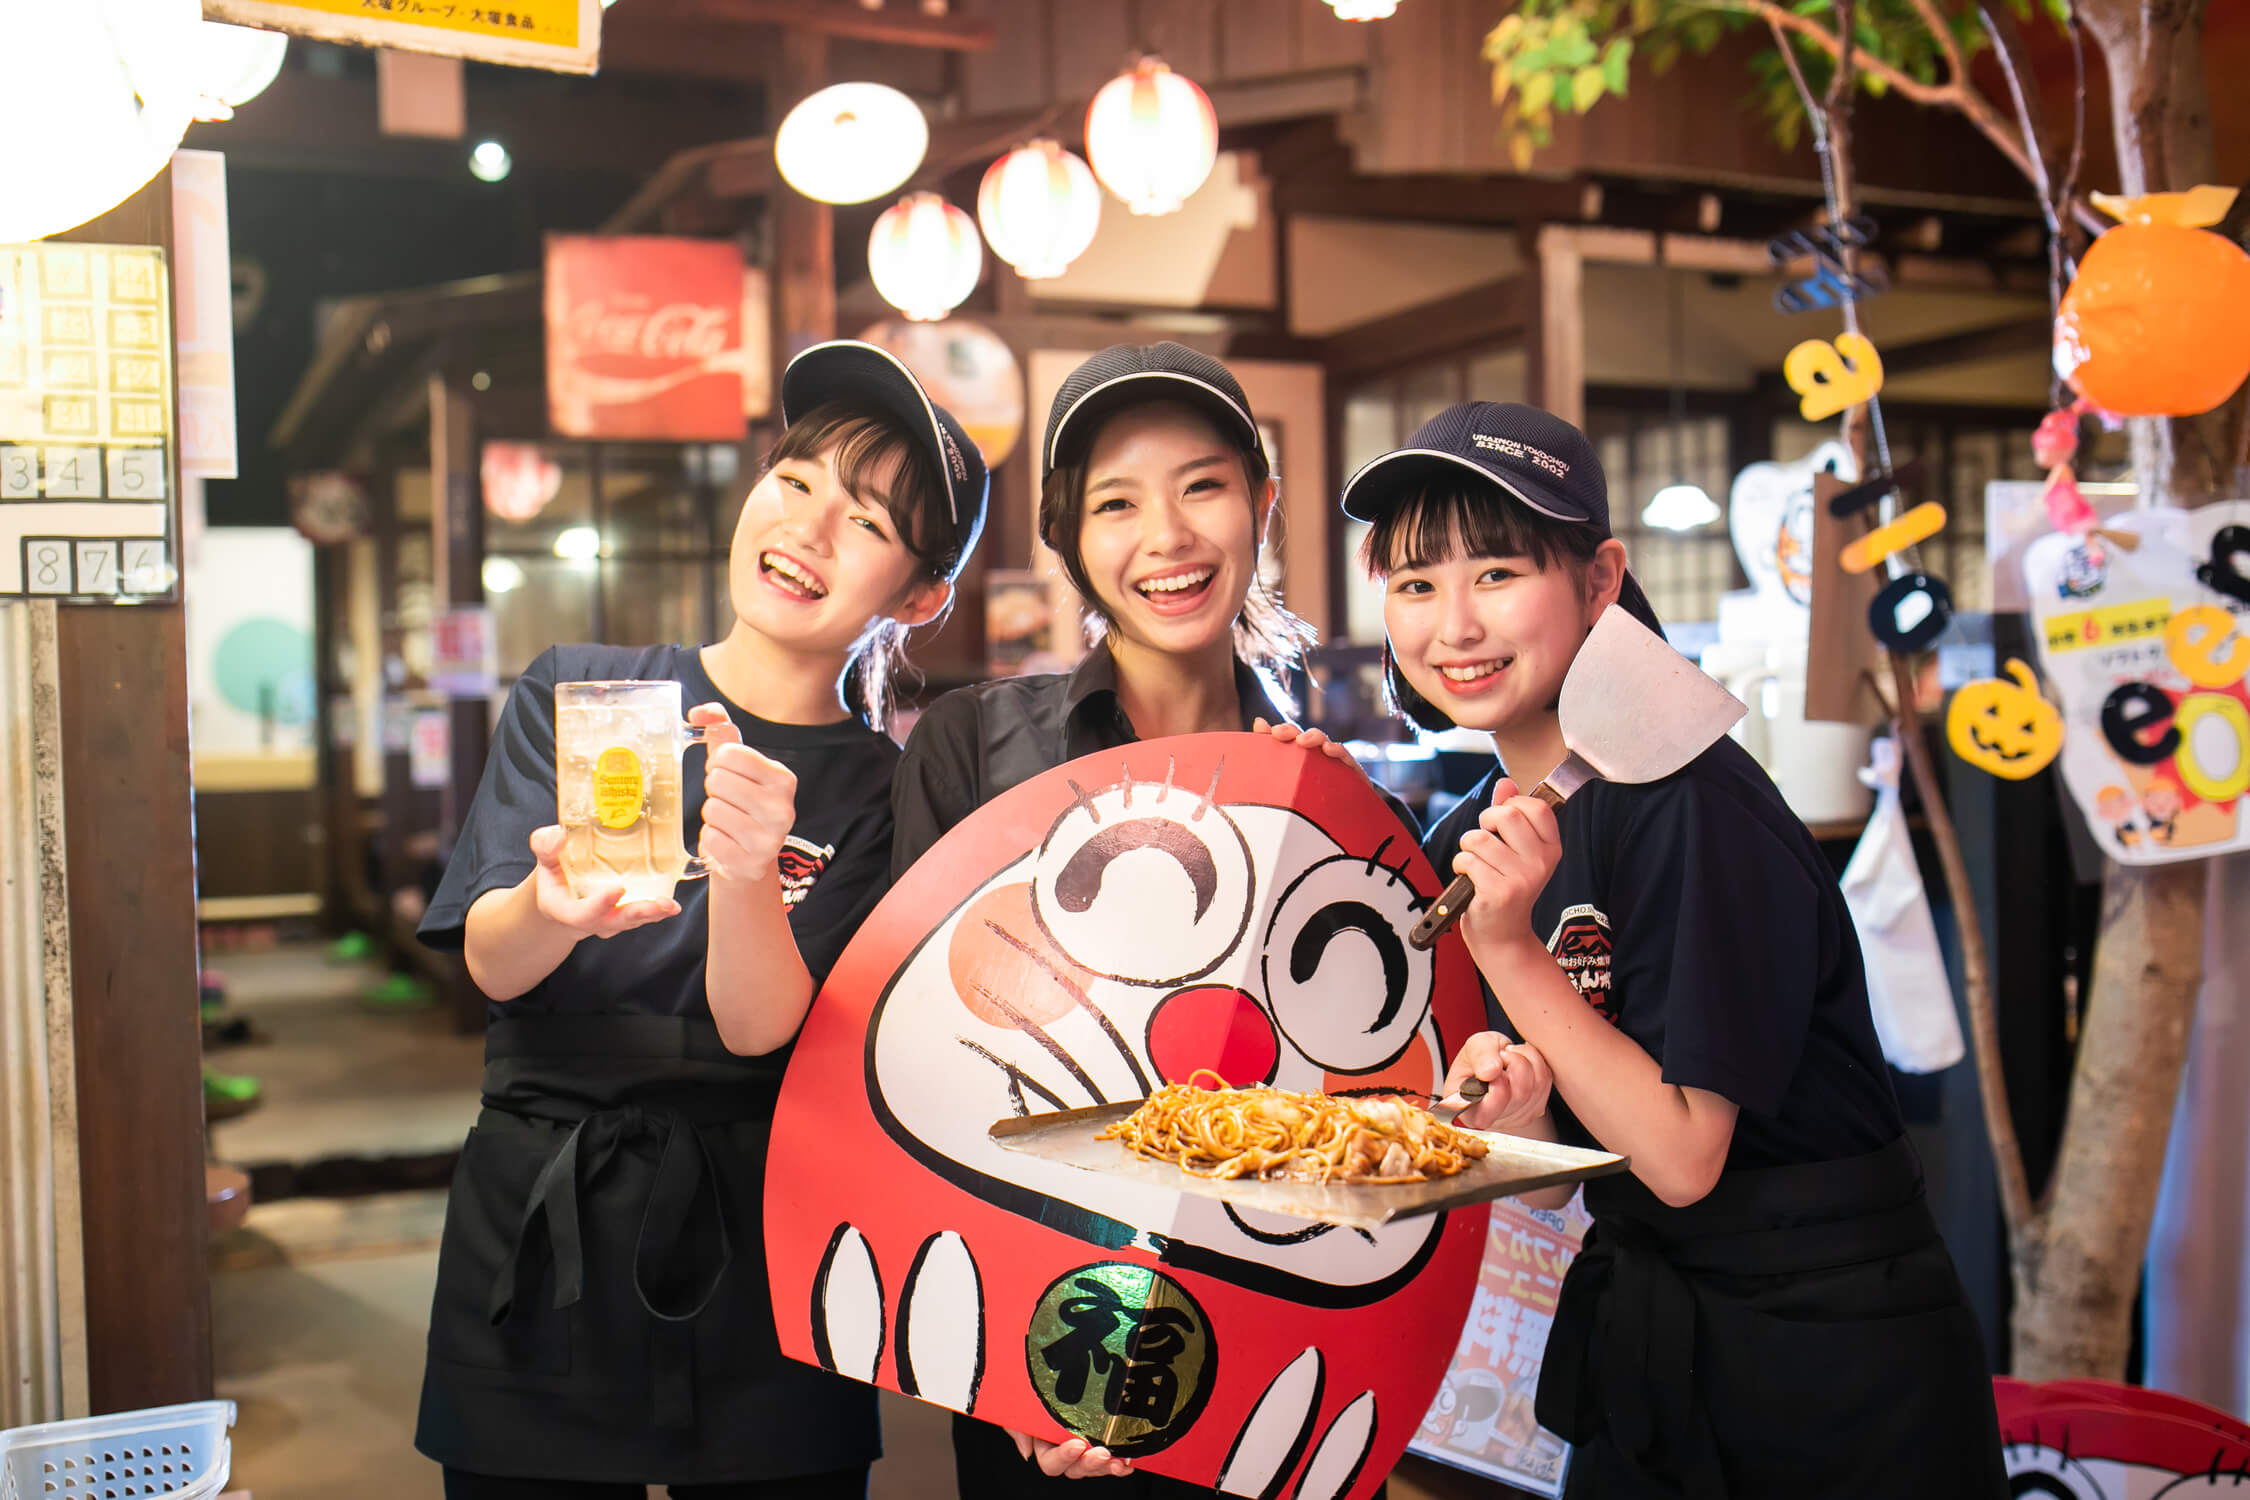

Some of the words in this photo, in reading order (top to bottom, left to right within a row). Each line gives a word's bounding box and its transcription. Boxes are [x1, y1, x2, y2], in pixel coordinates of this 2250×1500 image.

[9, 455, 30, 490] 3
[59, 456, 85, 491] 4
[121, 456, 144, 490] 5
[1531, 456, 1565, 479] 2002
[37, 546, 58, 584] 8
[84, 549, 108, 583] 7
[1041, 1278, 1194, 1428] 福
